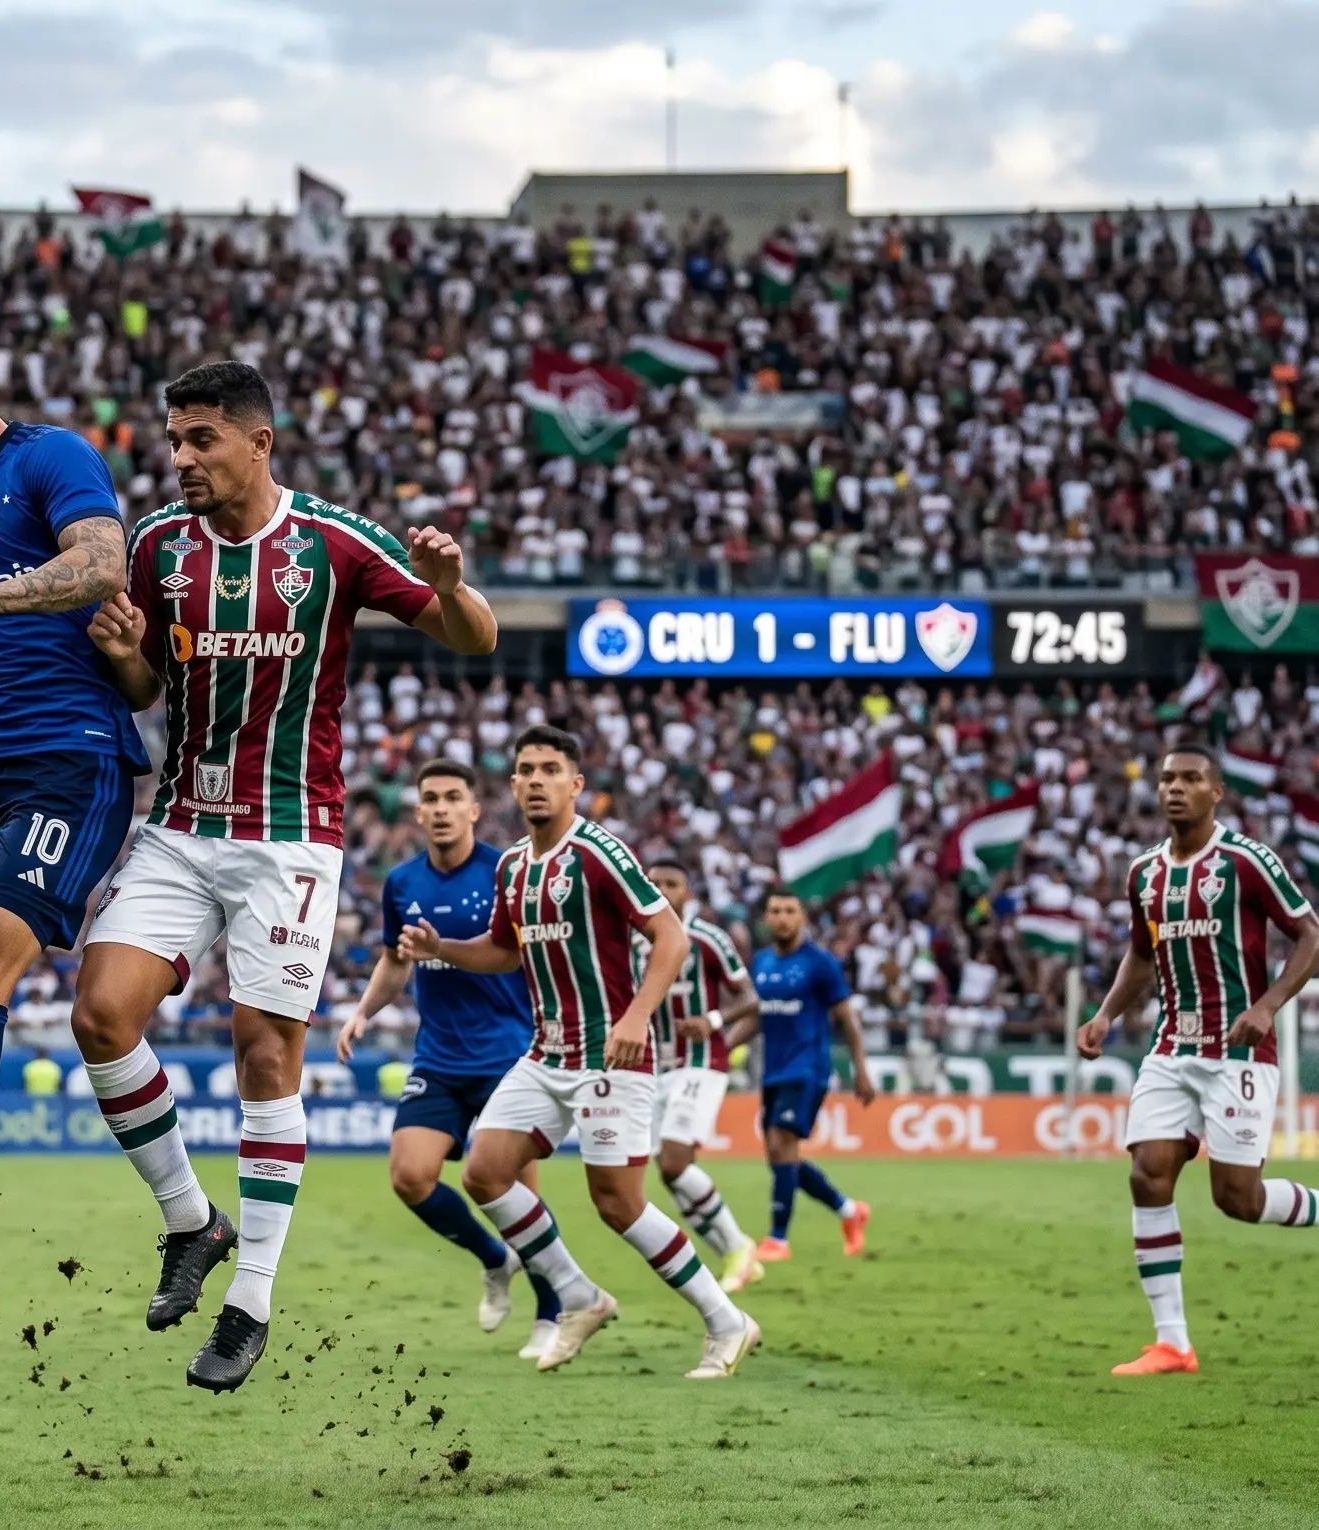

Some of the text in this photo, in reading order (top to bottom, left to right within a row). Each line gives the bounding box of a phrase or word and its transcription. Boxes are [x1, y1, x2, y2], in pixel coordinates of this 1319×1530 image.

[196, 632, 306, 657] BETANO
[648, 611, 735, 664] CRU
[753, 611, 777, 664] 1
[829, 611, 906, 664] FLU
[1006, 611, 1128, 666] 72:45
[21, 812, 70, 865] 10
[294, 874, 317, 924] 7
[1158, 918, 1222, 941] BETANO
[1241, 1069, 1255, 1101] 6
[889, 1103, 997, 1151] GOL
